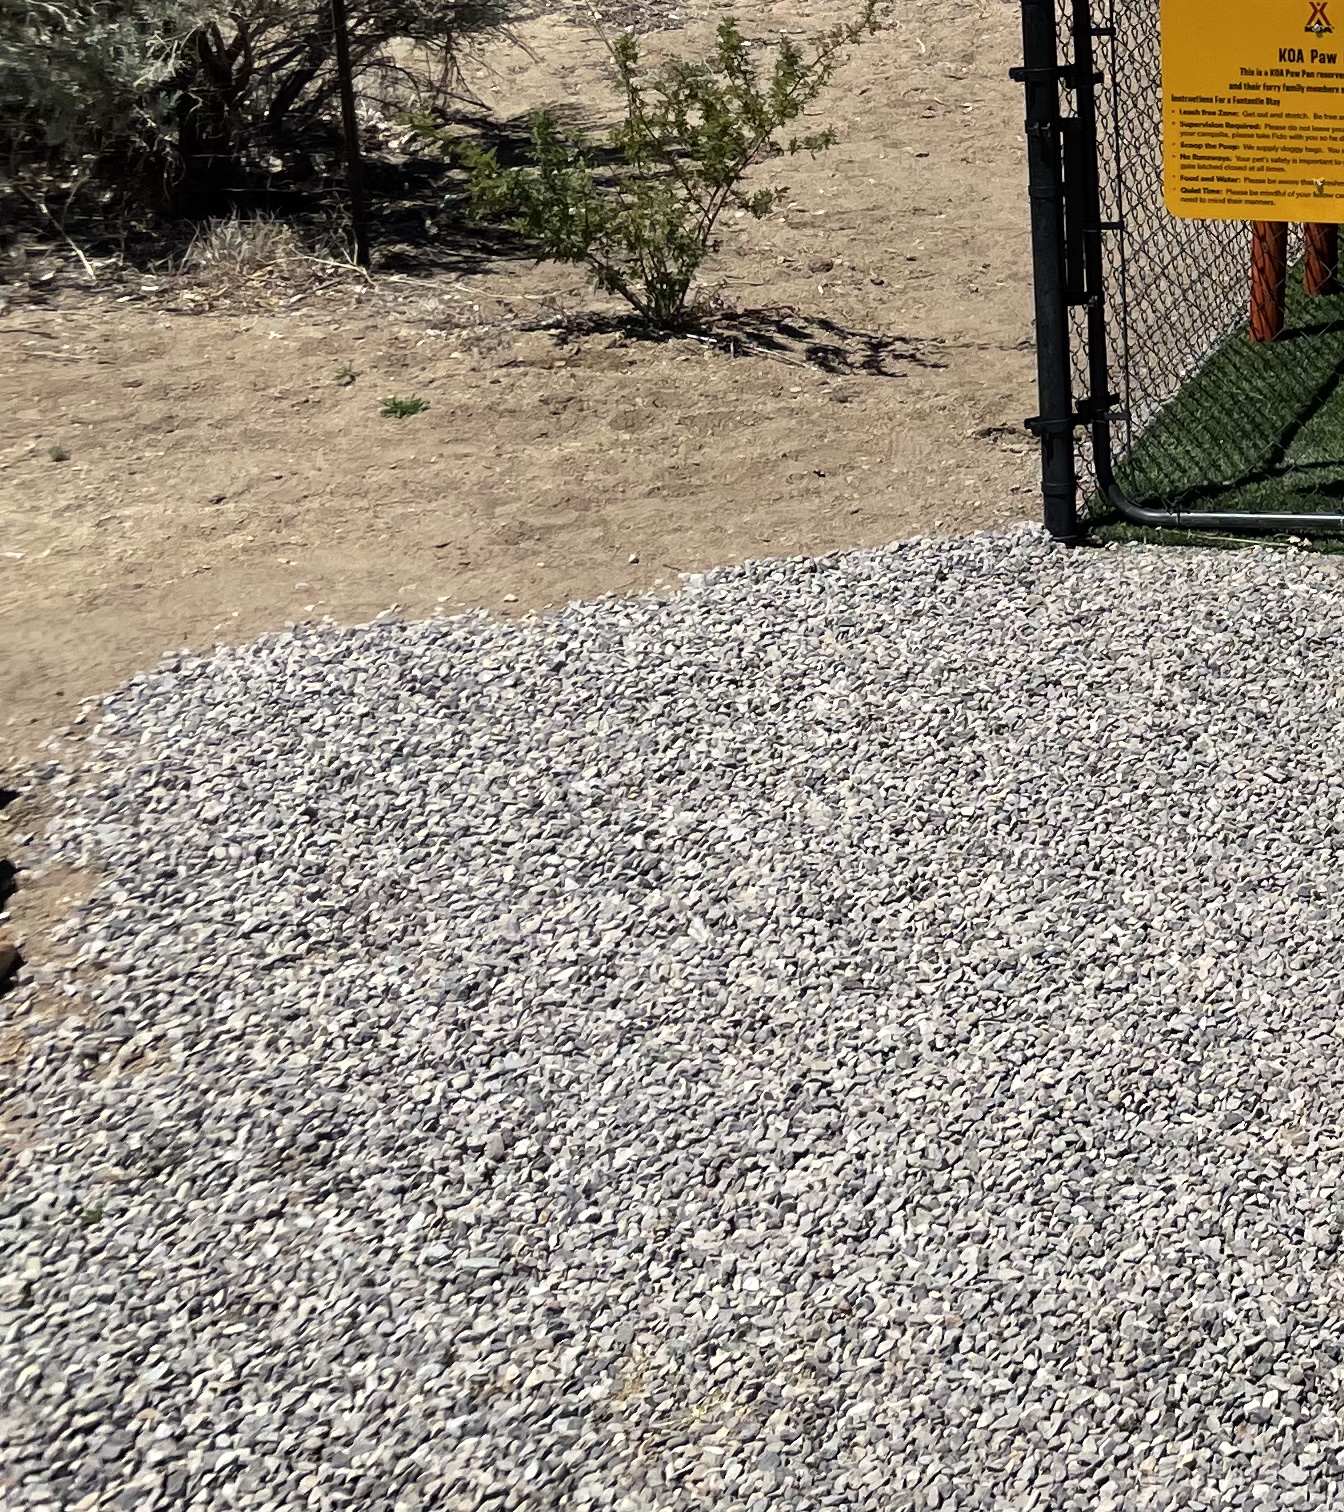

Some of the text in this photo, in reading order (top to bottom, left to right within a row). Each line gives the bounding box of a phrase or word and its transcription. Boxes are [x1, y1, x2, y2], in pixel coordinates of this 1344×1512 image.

[1278, 48, 1304, 63] KOA
[1310, 49, 1337, 64] Paw
[1240, 67, 1255, 76] This
[1256, 68, 1262, 77] is
[1269, 68, 1284, 77] KOA
[1285, 69, 1301, 77] Paw
[1301, 69, 1315, 78] Pen
[1229, 82, 1242, 90] and
[1243, 82, 1261, 91] their
[1263, 82, 1281, 92] furry
[1282, 83, 1305, 93] family
[1306, 84, 1339, 94] members
[1265, 97, 1280, 107] Stay
